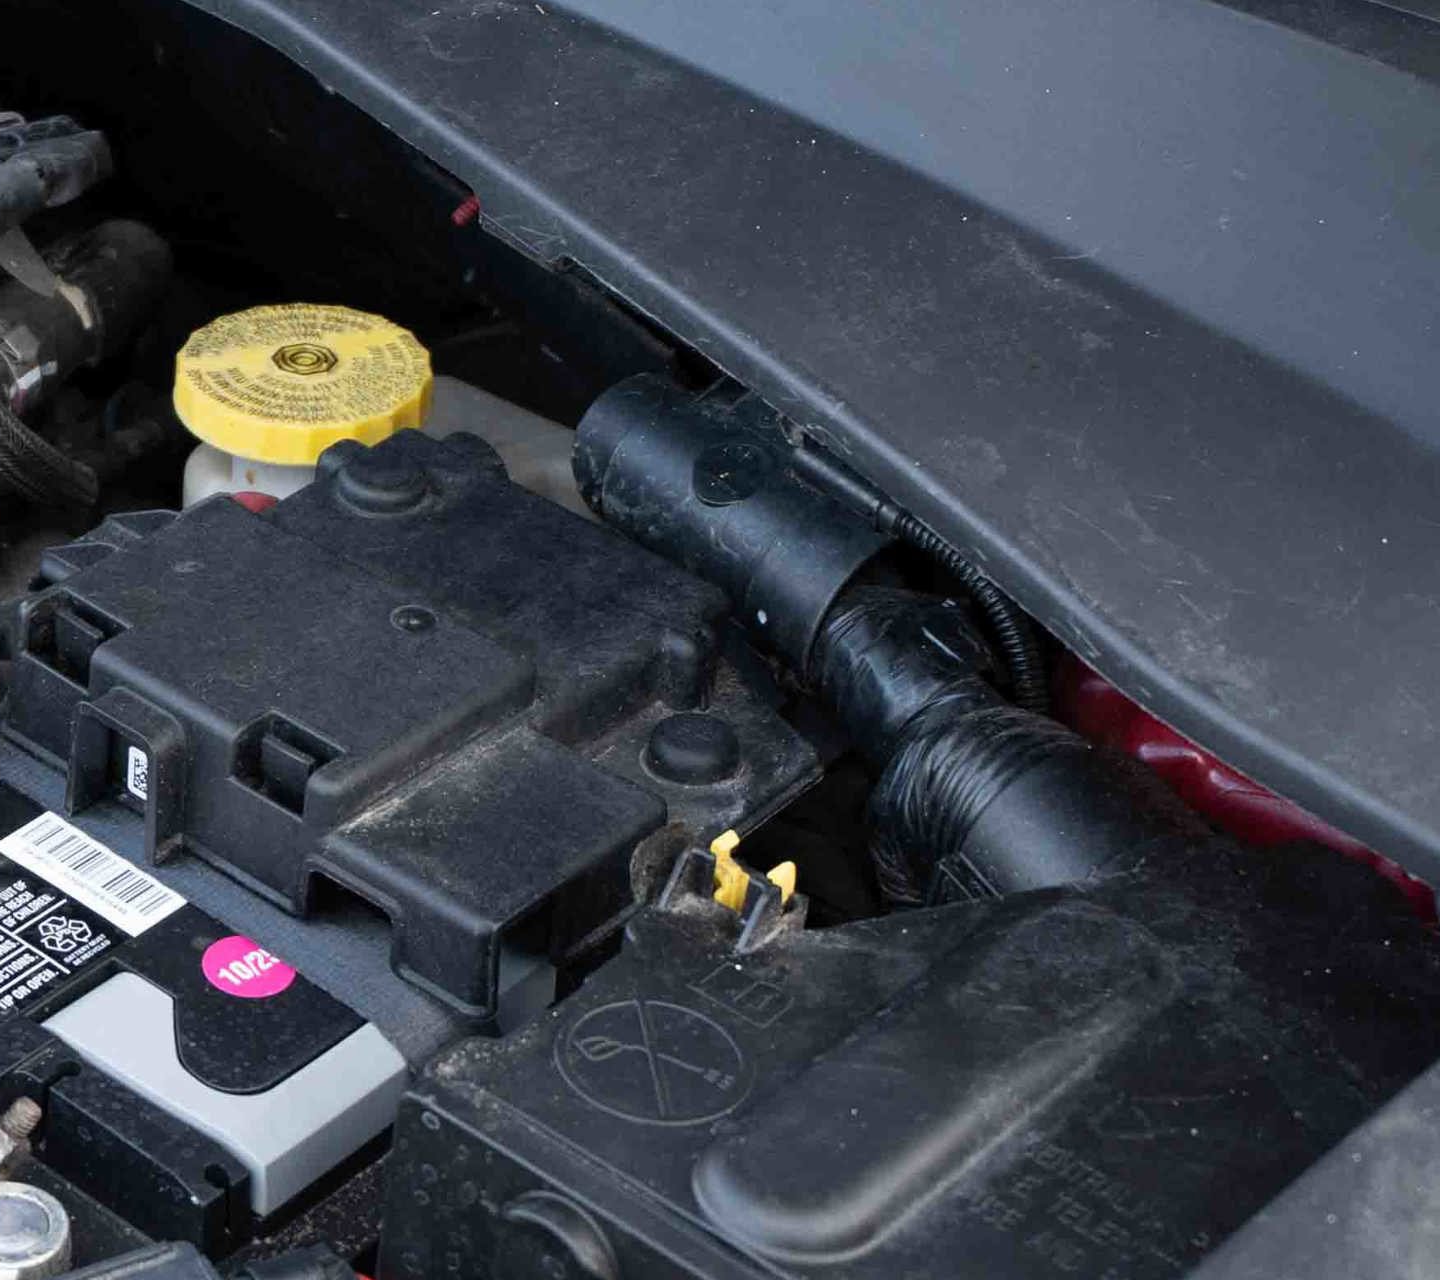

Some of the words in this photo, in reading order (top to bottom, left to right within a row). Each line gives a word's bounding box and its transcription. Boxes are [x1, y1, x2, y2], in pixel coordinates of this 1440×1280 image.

[13, 880, 27, 891] OF
[2, 916, 16, 927] OF
[13, 894, 55, 920] CHILDREN.
[5, 891, 34, 911] REACH
[12, 985, 31, 999] OR
[26, 969, 59, 990] OPEN.
